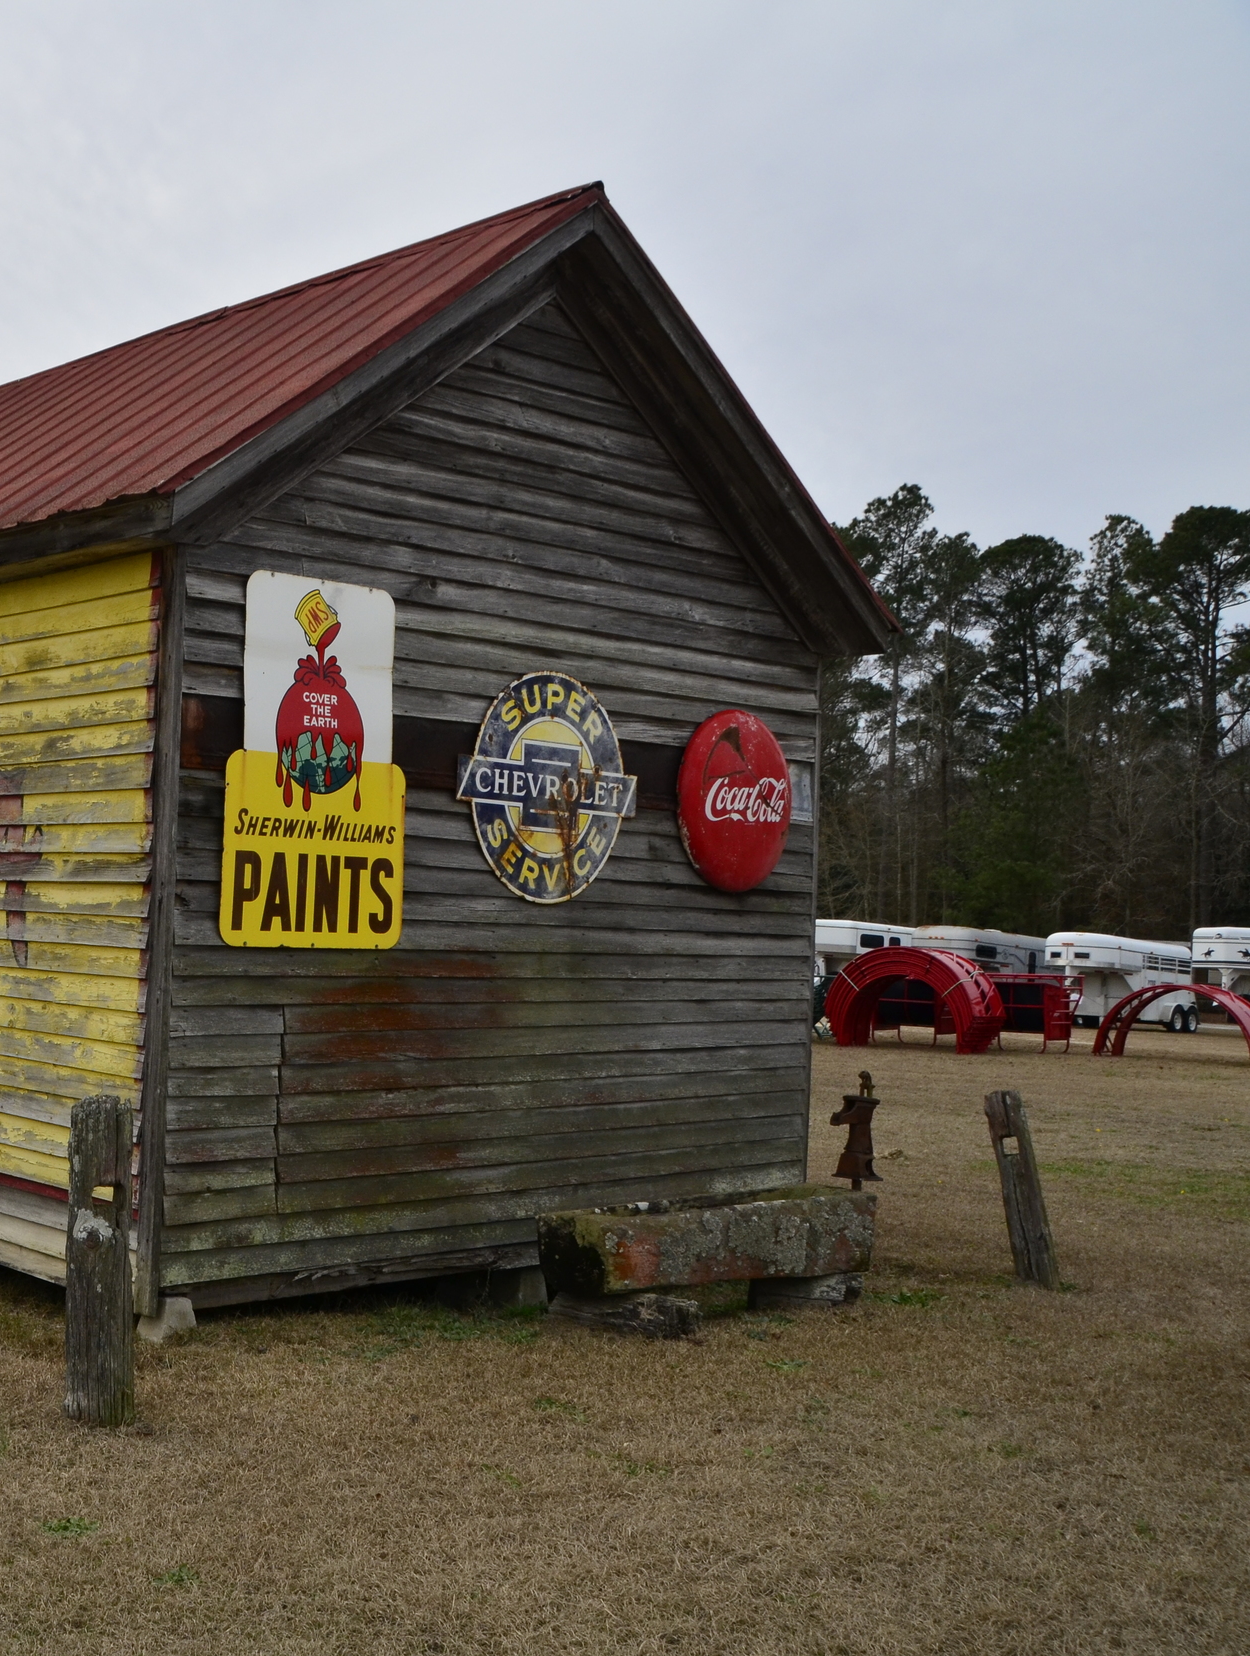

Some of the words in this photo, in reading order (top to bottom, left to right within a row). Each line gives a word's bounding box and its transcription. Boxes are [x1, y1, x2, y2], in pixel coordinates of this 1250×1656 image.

[304, 601, 329, 634] SWP
[302, 691, 338, 706] COVER
[310, 704, 332, 717] THE
[501, 683, 603, 744] SUPER
[303, 715, 338, 729] EARTH
[475, 767, 624, 807] CHEVROLET
[705, 776, 787, 823] Coca-Cola
[230, 850, 395, 934] PAINTS
